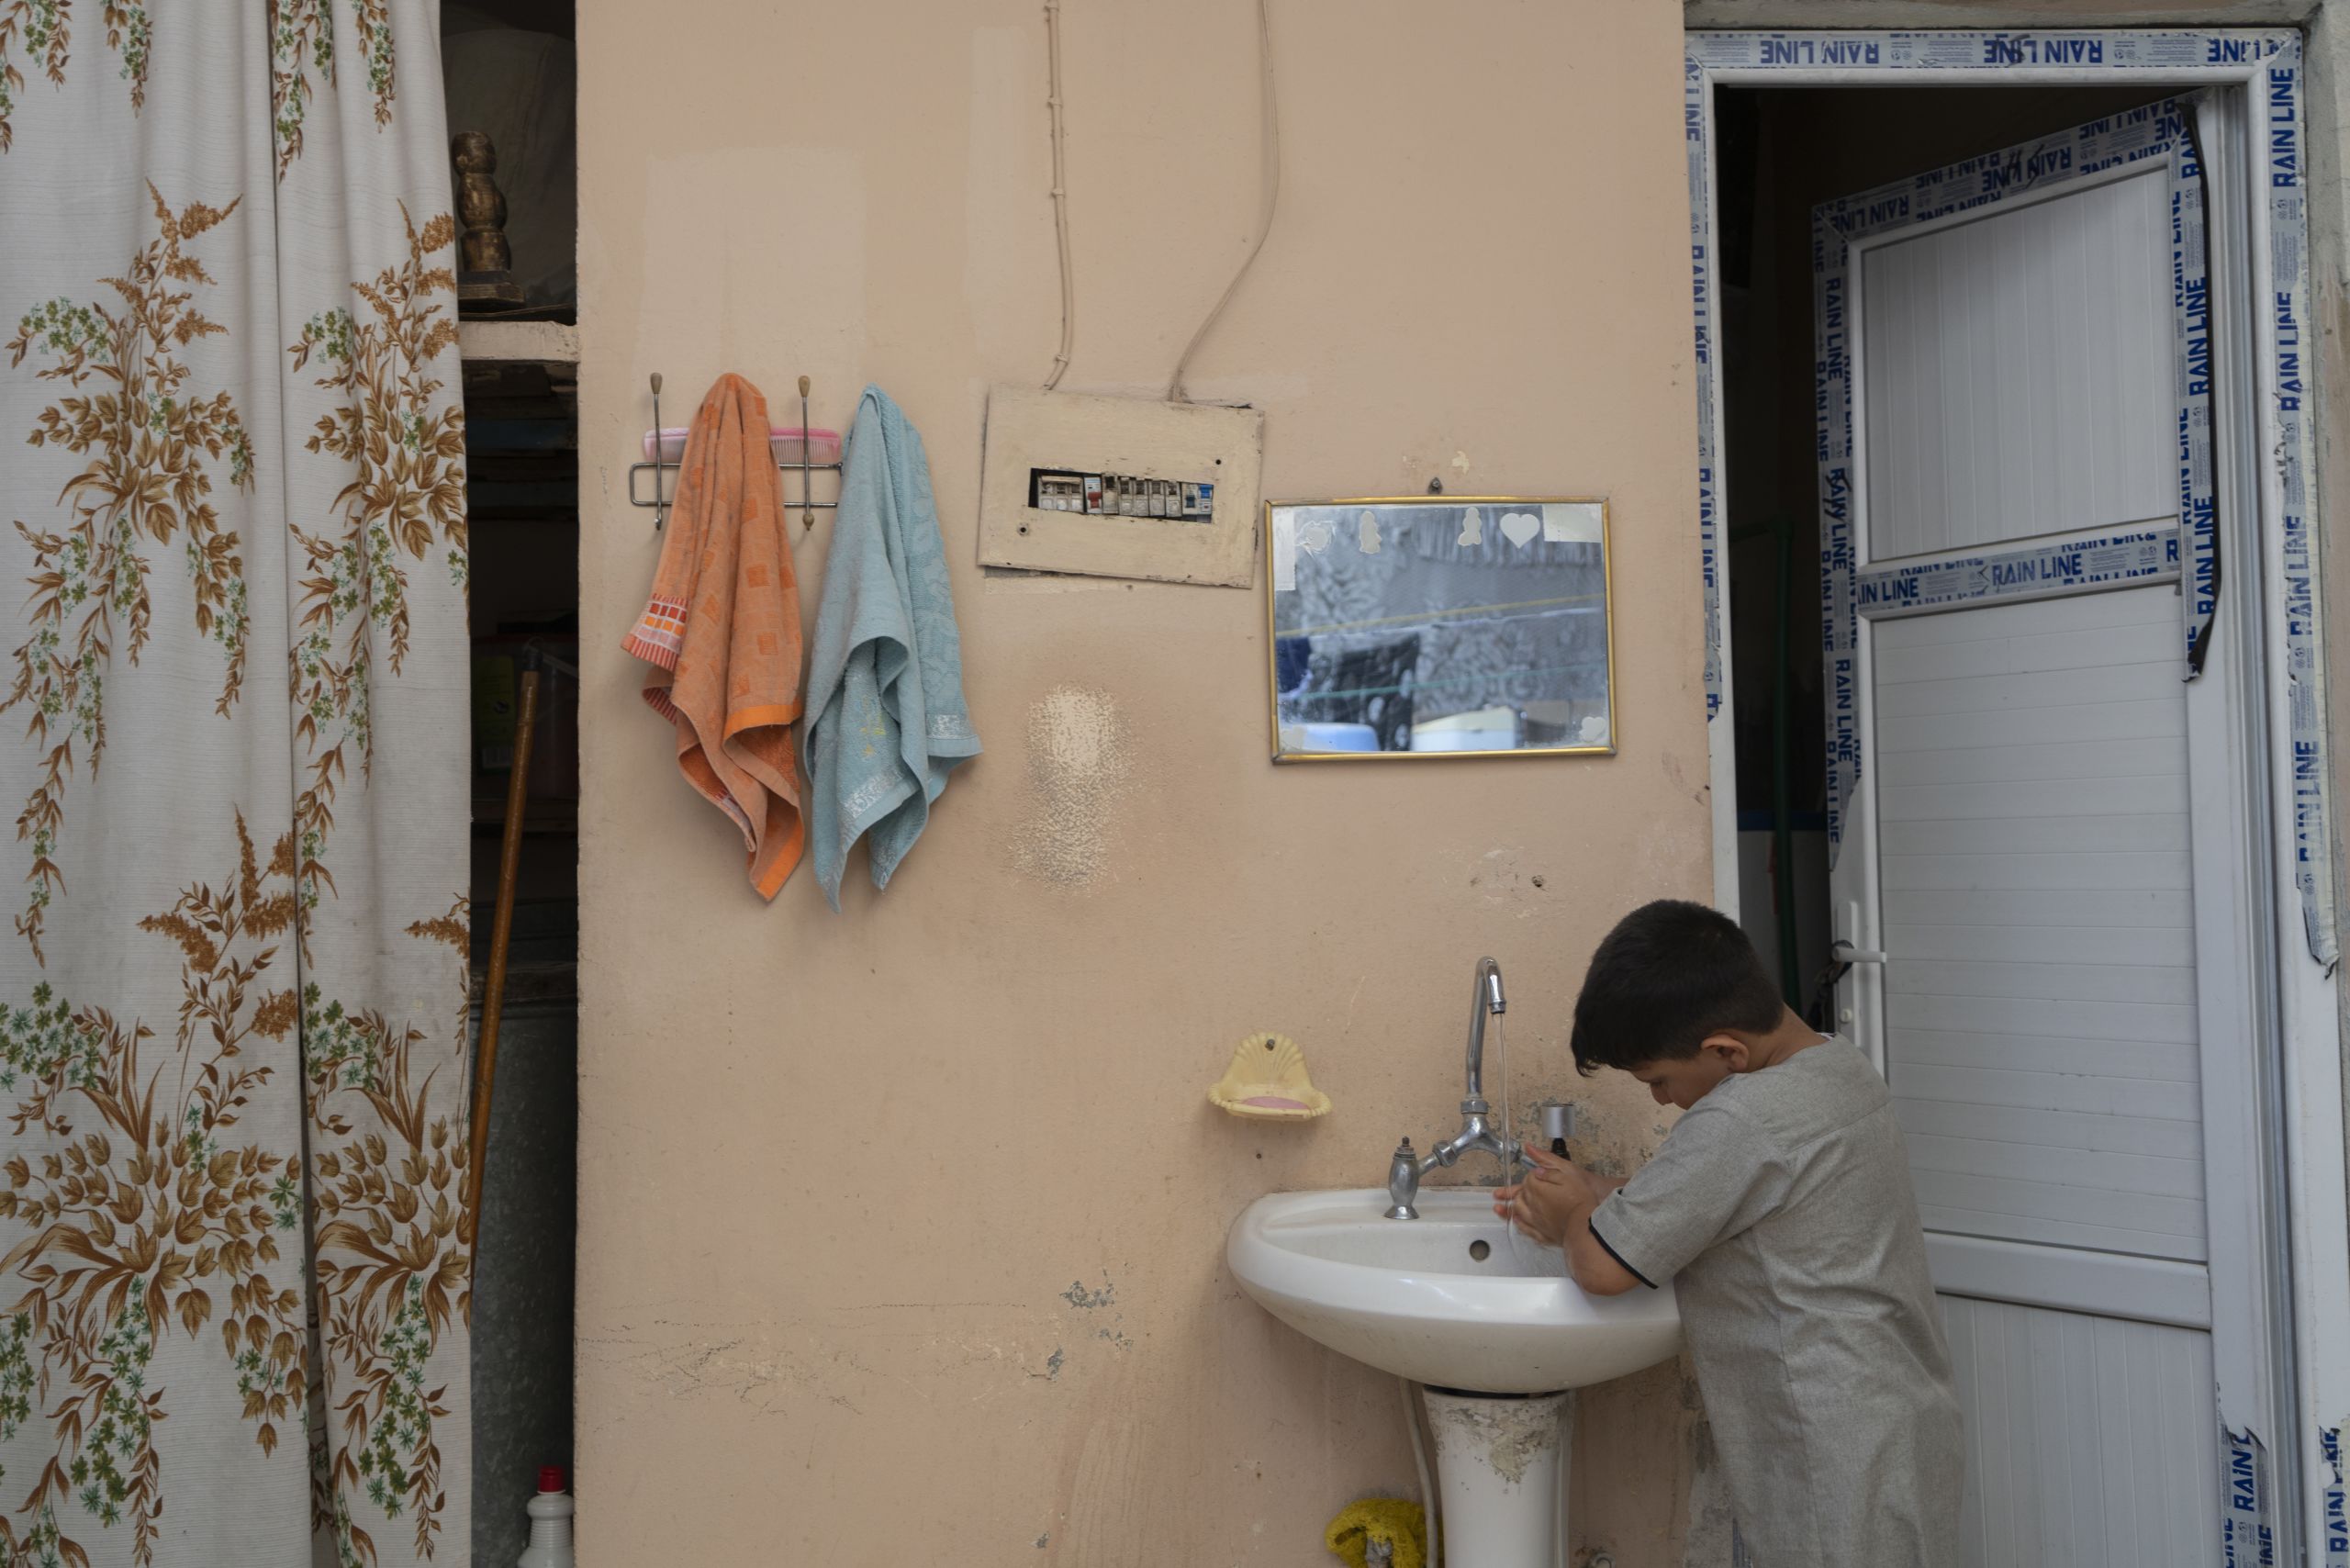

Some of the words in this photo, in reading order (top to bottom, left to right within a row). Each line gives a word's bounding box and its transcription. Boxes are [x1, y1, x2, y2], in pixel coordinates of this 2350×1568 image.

[1760, 40, 1814, 64] LINE
[1821, 40, 1880, 64] RAIN
[1984, 39, 2038, 63] LINE
[2045, 39, 2102, 63] RAIN
[2270, 68, 2295, 122] LINE
[1981, 160, 2021, 193] LINE
[2027, 147, 2072, 179] RAIN
[2271, 129, 2298, 187] RAIN
[1870, 195, 1909, 225] RAIN
[1826, 277, 1841, 329] RAIN
[2185, 276, 2210, 333] LINE
[2277, 291, 2299, 345] LINE
[1827, 333, 1843, 382] LINE
[2187, 338, 2210, 397] RAIN
[2278, 353, 2302, 411] RAIN
[1830, 467, 1847, 519] RAIN
[1831, 524, 1849, 572] LINE
[2193, 496, 2214, 551] LINE
[2285, 515, 2310, 570] LINE
[1882, 577, 1919, 601] LINE
[1992, 559, 2036, 586] RAIN
[2041, 553, 2083, 579] LINE
[2195, 556, 2216, 616] RAIN
[1835, 658, 1852, 710] RAIN
[1837, 715, 1853, 762] LINE
[2295, 741, 2321, 796] LINE
[2232, 1449, 2255, 1513] RAIN
[2327, 1492, 2349, 1552] RAIN
